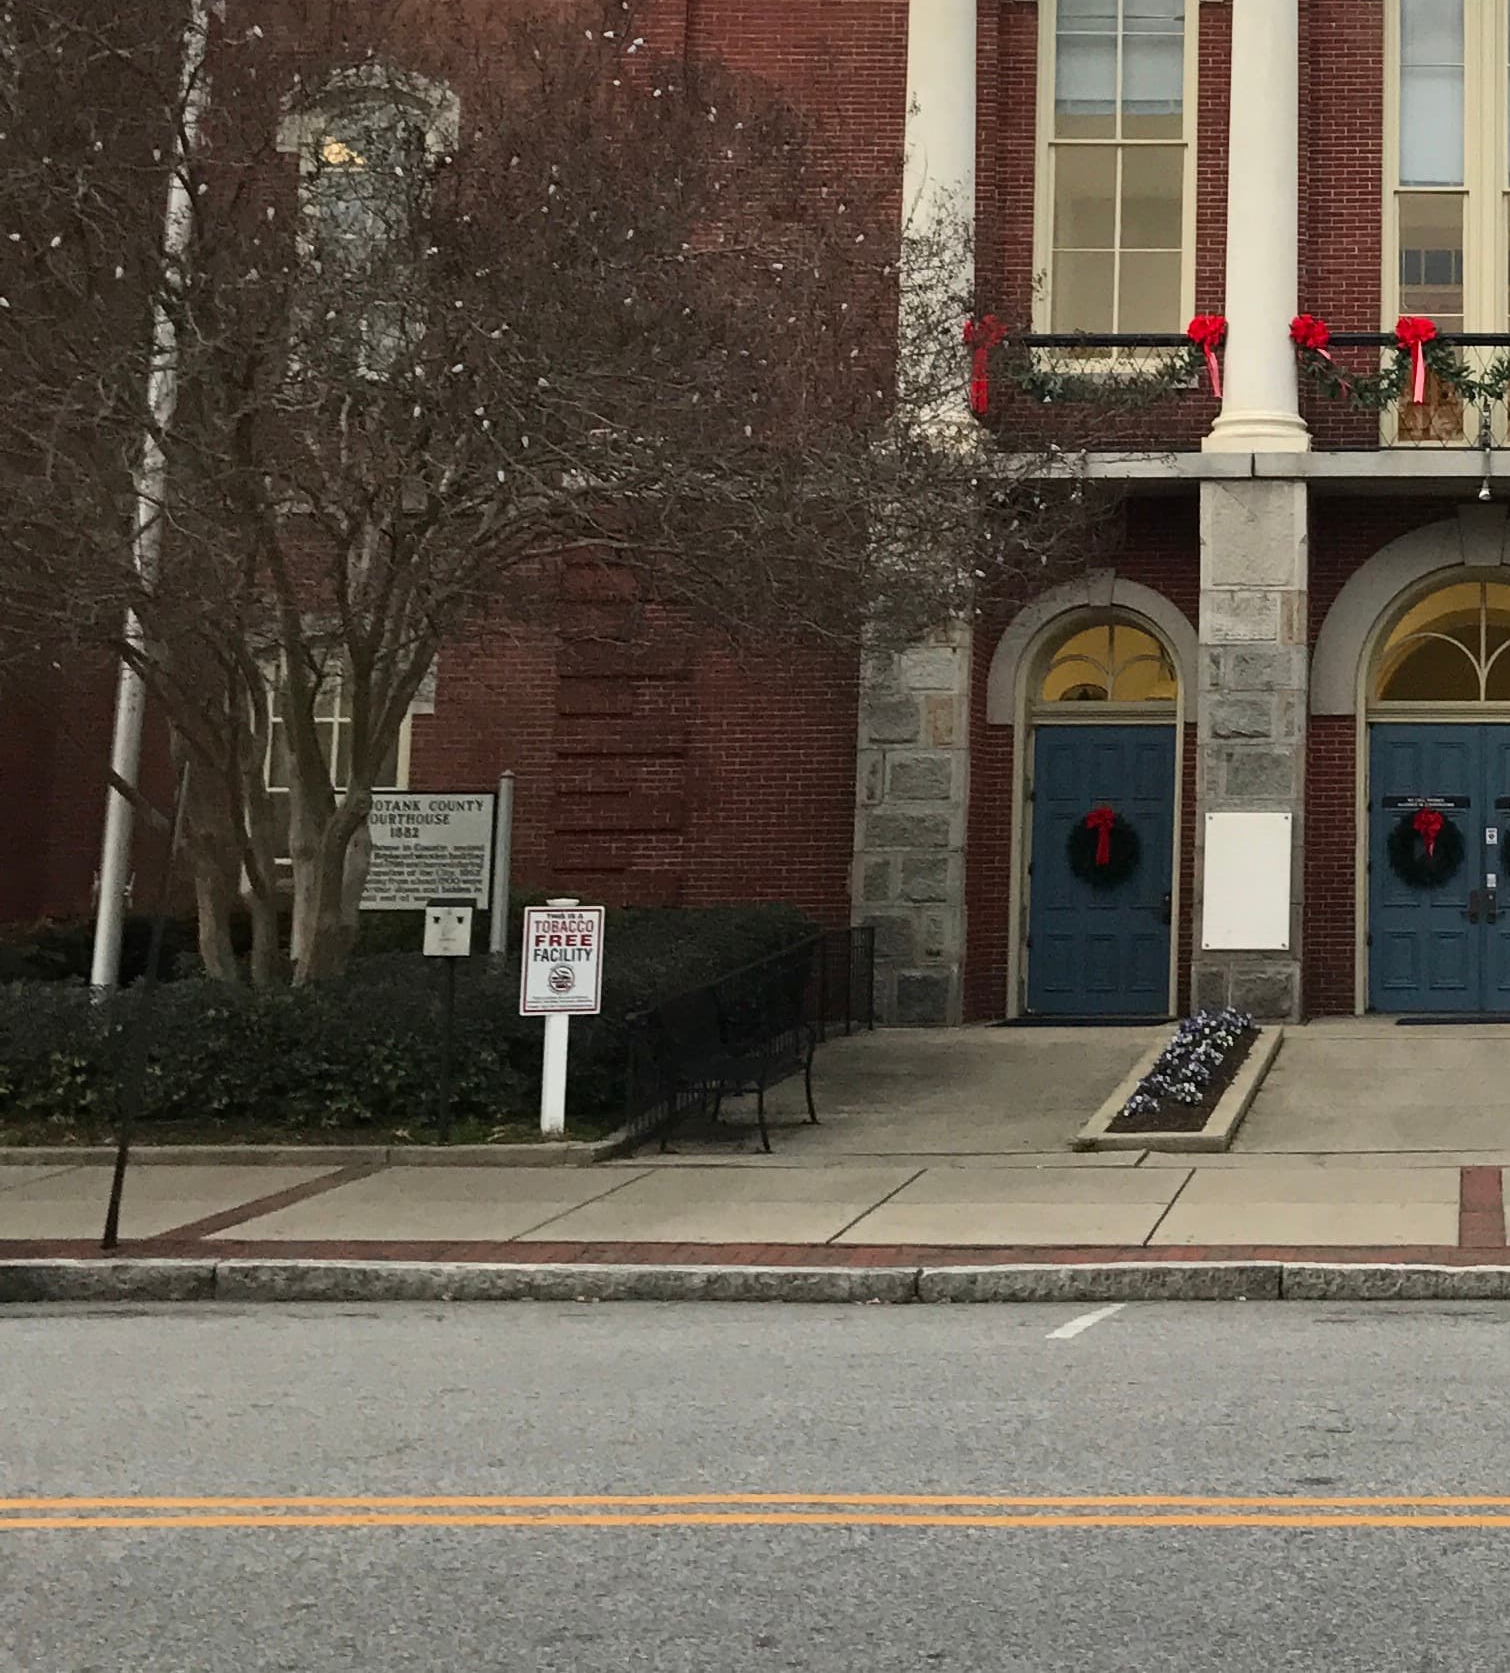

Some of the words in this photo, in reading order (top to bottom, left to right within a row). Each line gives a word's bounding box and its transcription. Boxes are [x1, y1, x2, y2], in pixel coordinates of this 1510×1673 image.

[371, 800, 421, 812] OTANK
[428, 800, 484, 812] COUNTY
[369, 813, 451, 825] OURTHOUSE
[534, 920, 594, 934] TOBACCO
[535, 934, 593, 947] FREE
[533, 948, 593, 962] FACILITY
